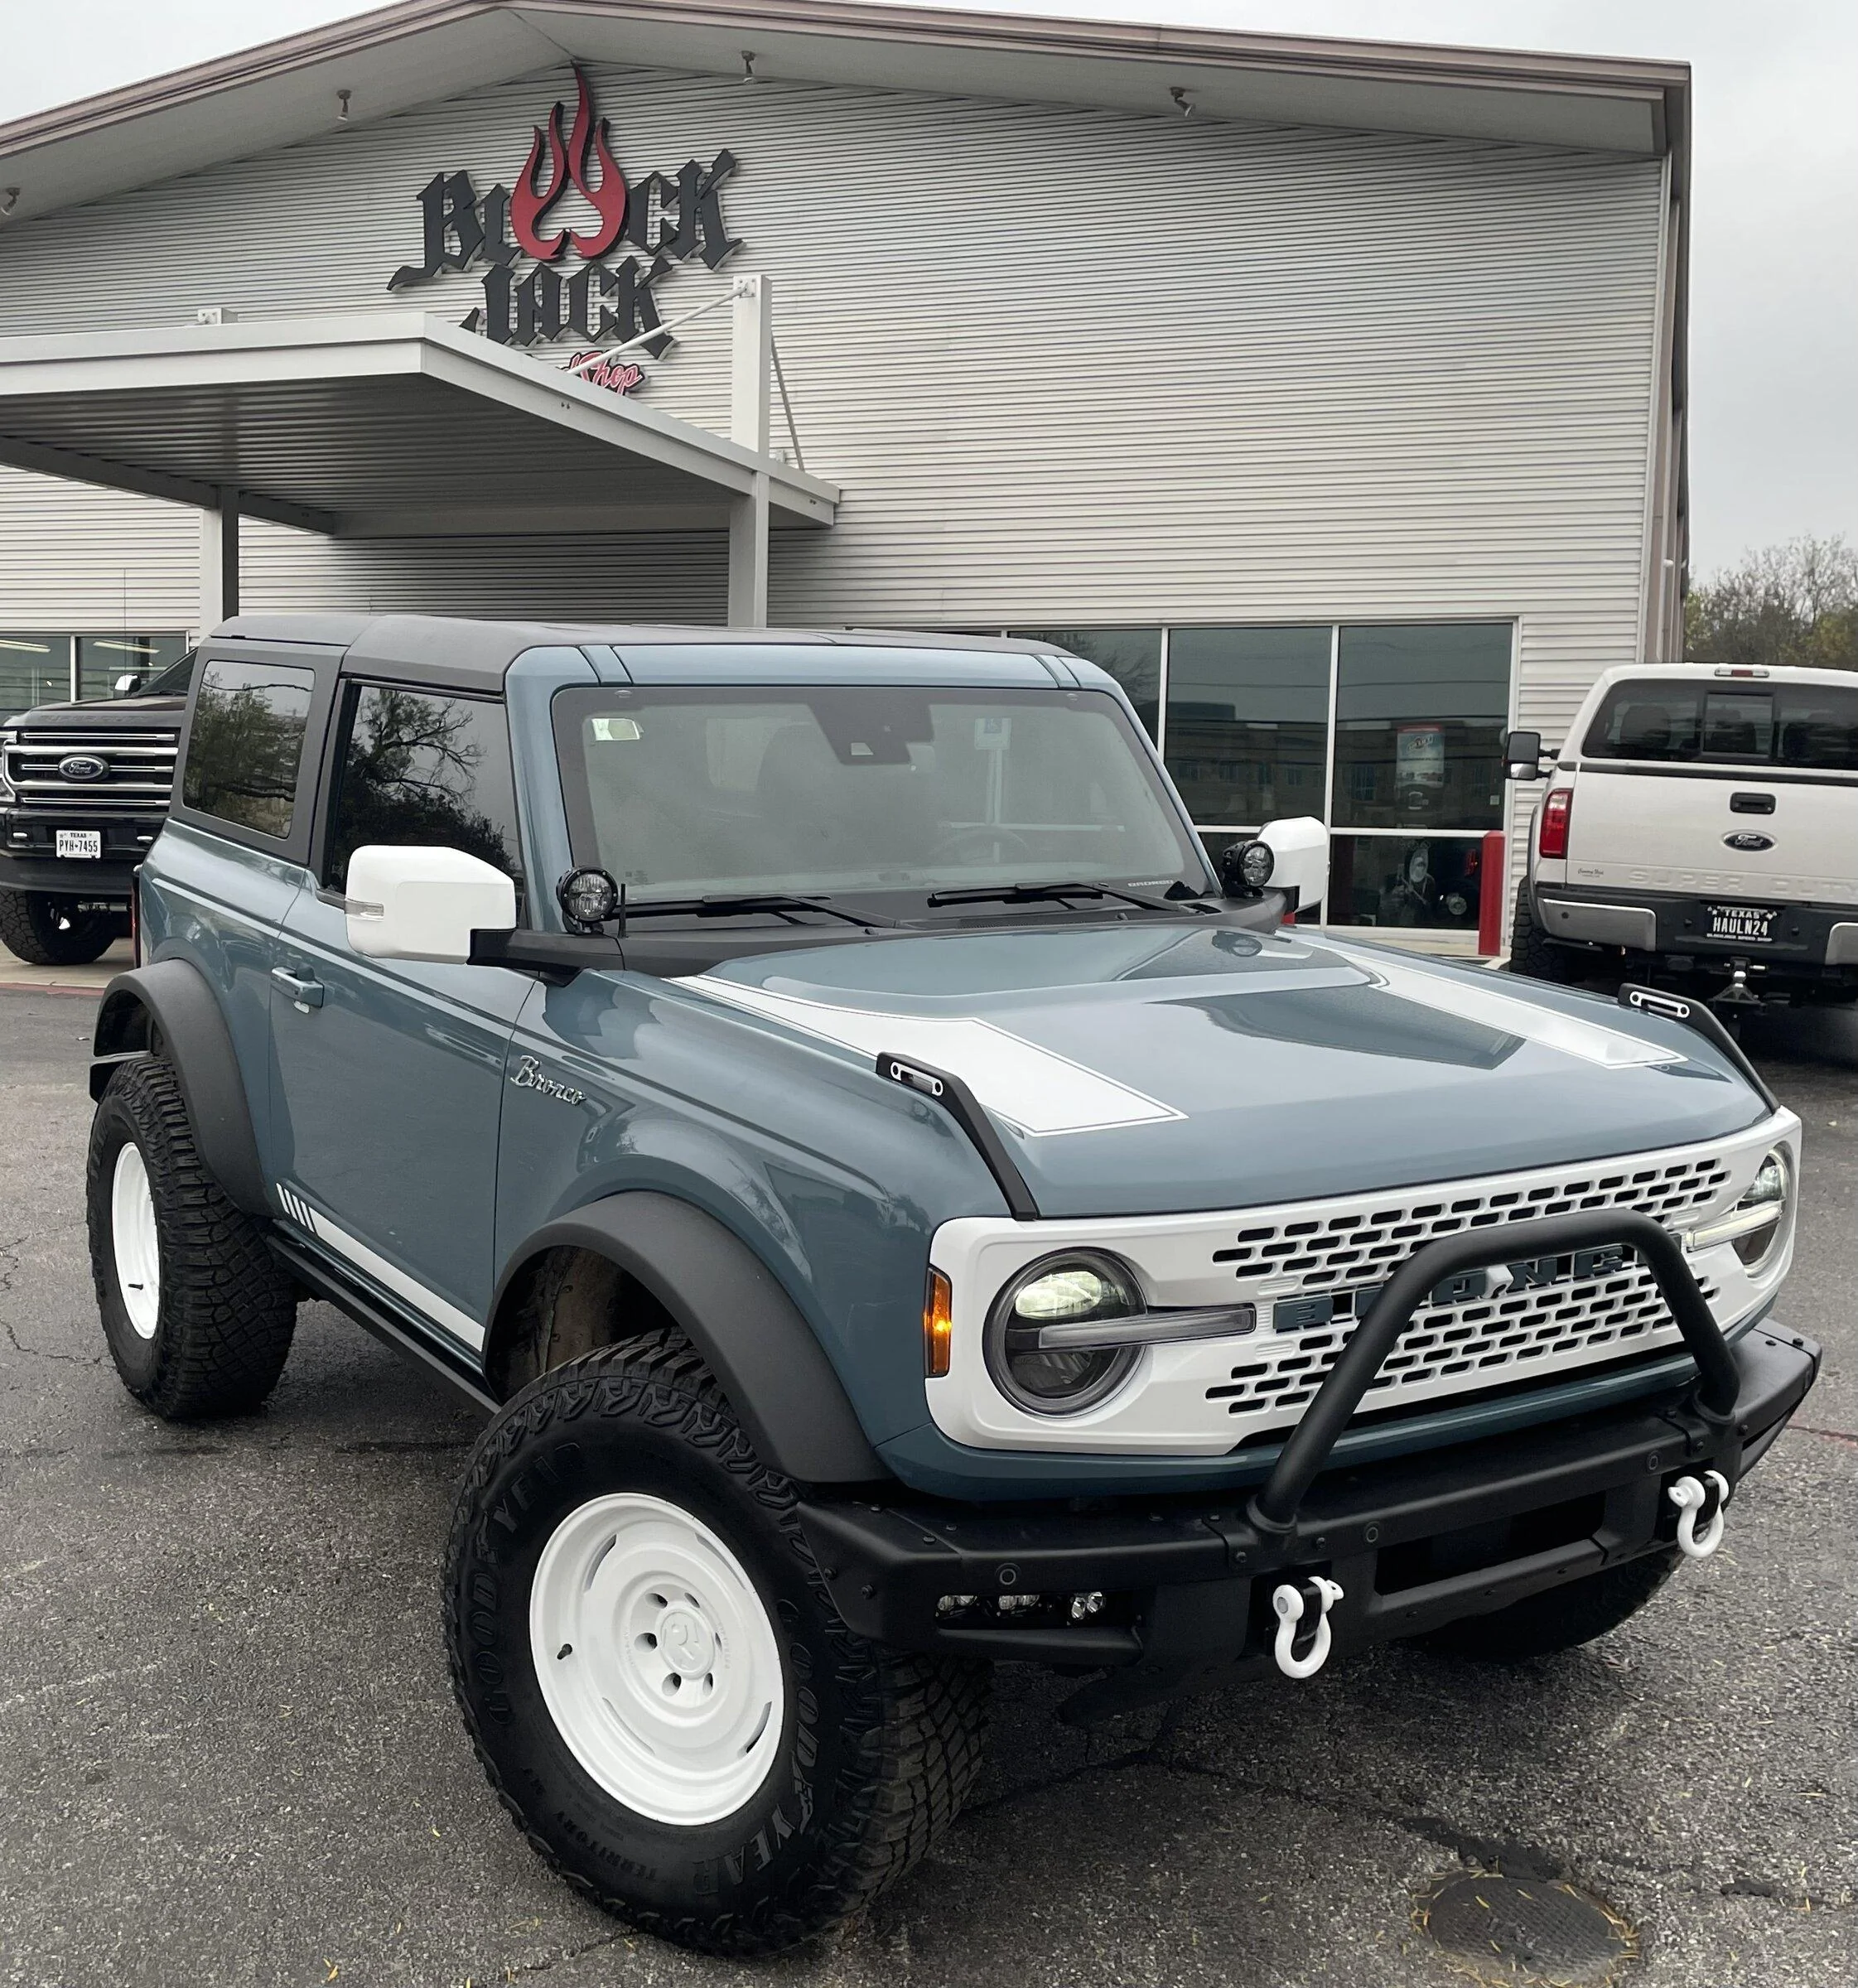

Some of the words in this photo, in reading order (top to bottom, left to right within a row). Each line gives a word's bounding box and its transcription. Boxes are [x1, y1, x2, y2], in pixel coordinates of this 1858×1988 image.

[459, 255, 679, 360] JACK
[69, 760, 91, 774] Ford
[1735, 834, 1763, 847] Ford
[1629, 868, 1745, 893] SUPER
[1725, 910, 1760, 919] TEXAS
[1713, 917, 1768, 936] HAULN24
[510, 1054, 587, 1104] Bronco
[693, 1598, 822, 1895] GOODYEAR
